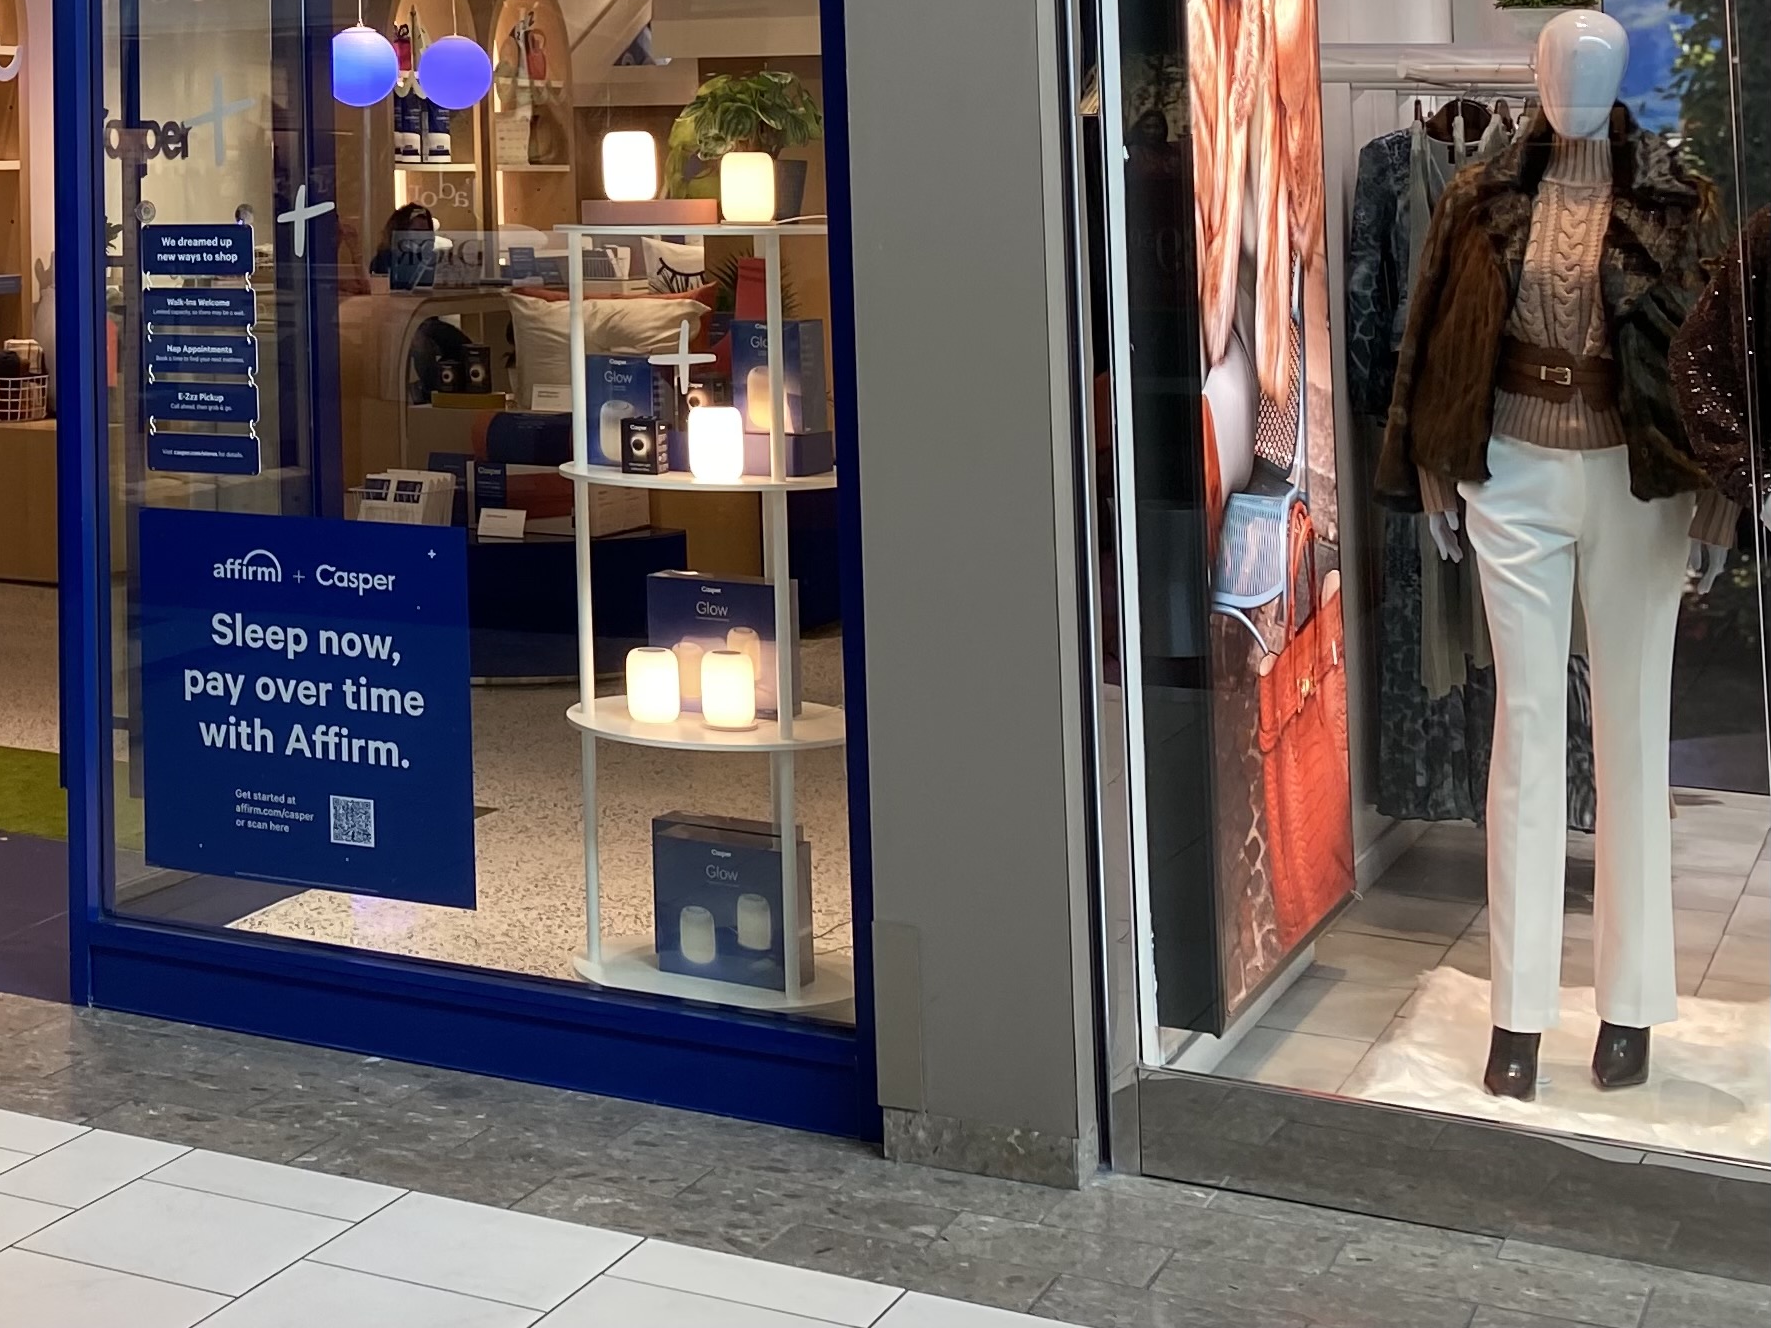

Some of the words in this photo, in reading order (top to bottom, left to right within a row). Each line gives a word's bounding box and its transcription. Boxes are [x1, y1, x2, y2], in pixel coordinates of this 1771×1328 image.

[161, 236, 176, 247] We
[177, 236, 218, 247] dreamed
[219, 238, 233, 249] up
[156, 253, 176, 262] new
[177, 252, 201, 264] ways
[202, 252, 213, 262] to
[214, 251, 239, 264] shop
[604, 371, 633, 385] Glow
[199, 392, 224, 403] Pickup
[213, 549, 282, 582] affirm
[316, 564, 396, 596] Casper
[695, 601, 729, 617] Glow
[211, 612, 308, 660] Sleep
[319, 629, 401, 667] now,
[184, 668, 245, 706] pay
[255, 675, 333, 707] over
[342, 676, 425, 717] time
[198, 715, 274, 754] with
[285, 723, 410, 769] Affirm.
[235, 788, 251, 801] Get
[252, 790, 285, 804] started
[286, 794, 296, 805] at
[235, 803, 314, 822] affirm.com/casper
[235, 819, 245, 827] or
[247, 820, 268, 831] scan
[269, 821, 290, 833] here
[705, 863, 739, 881] Glow
